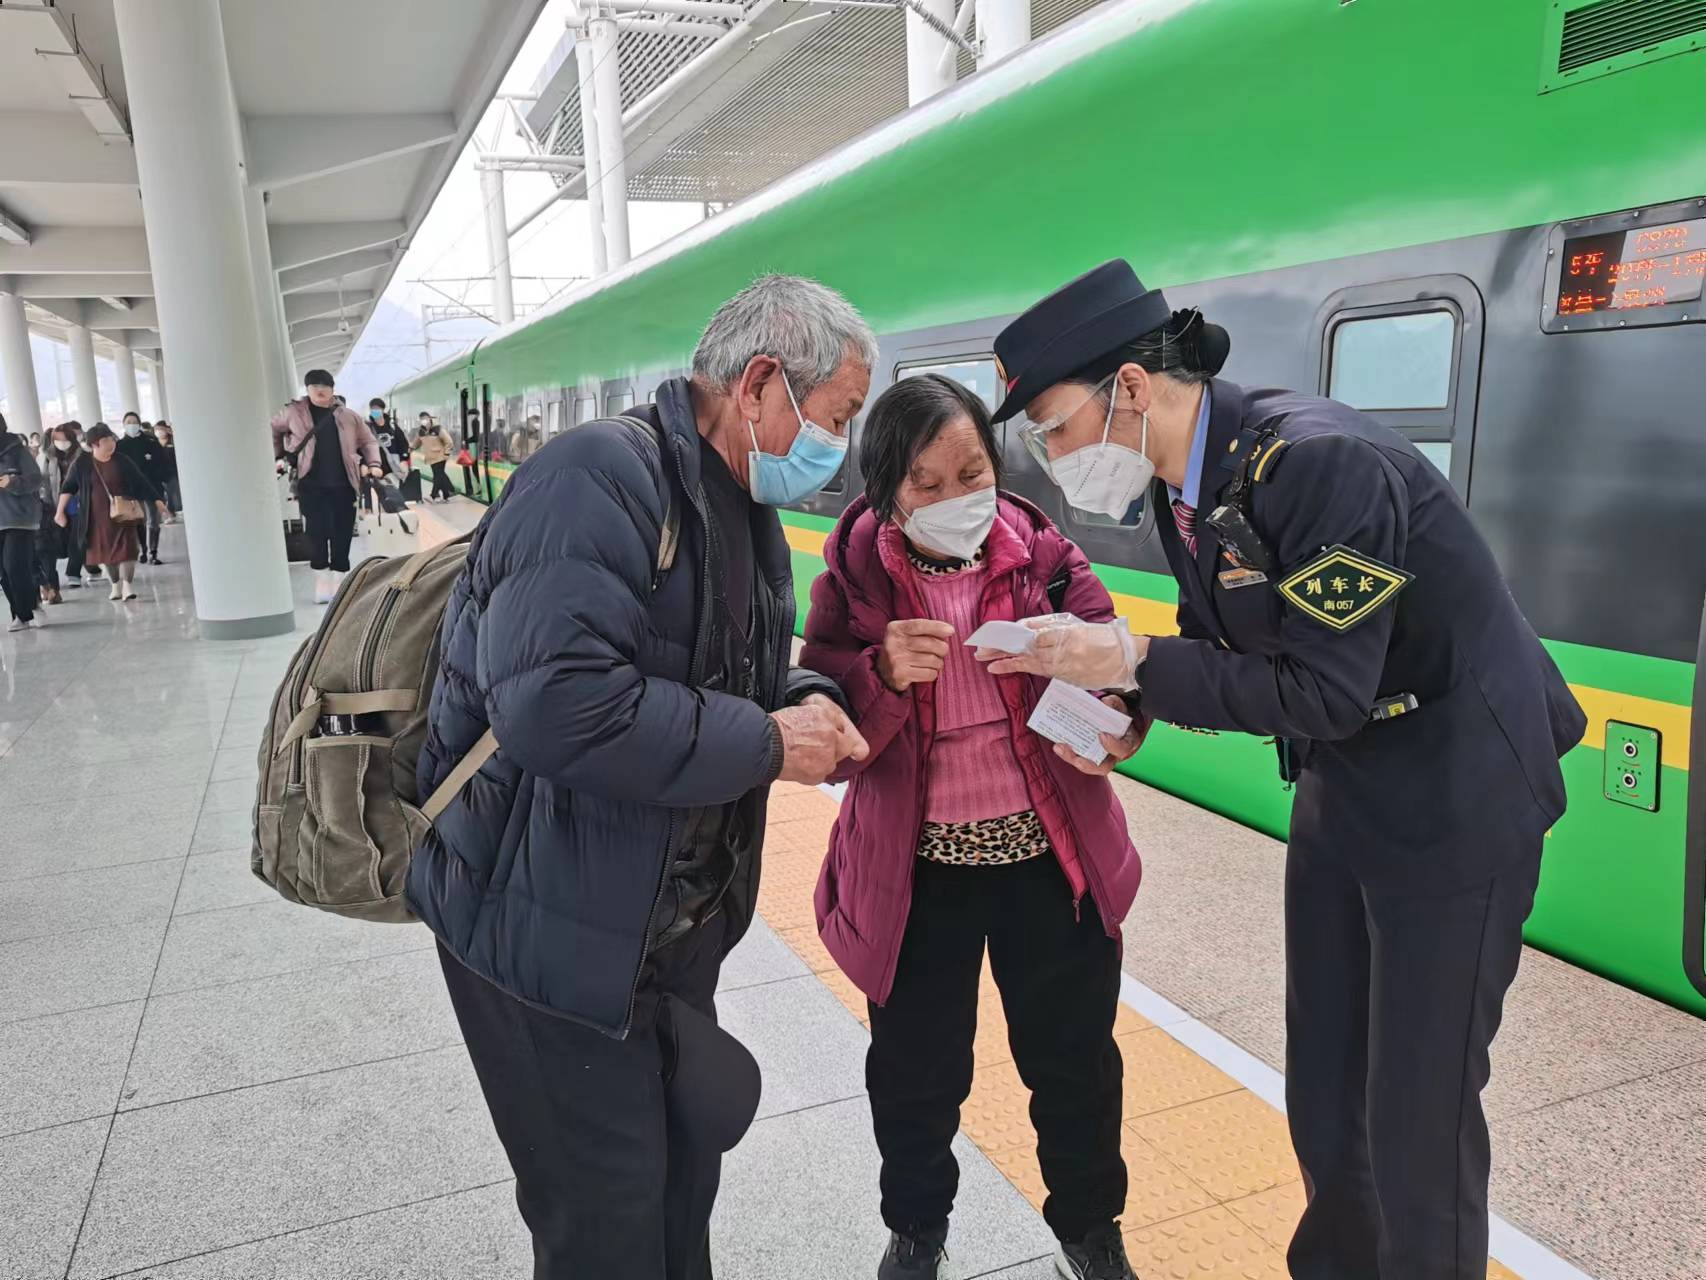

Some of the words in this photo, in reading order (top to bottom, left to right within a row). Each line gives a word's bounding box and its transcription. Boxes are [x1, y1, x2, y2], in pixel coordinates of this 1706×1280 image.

[1304, 575, 1375, 595] 列车长
[1323, 600, 1355, 611] 南057
